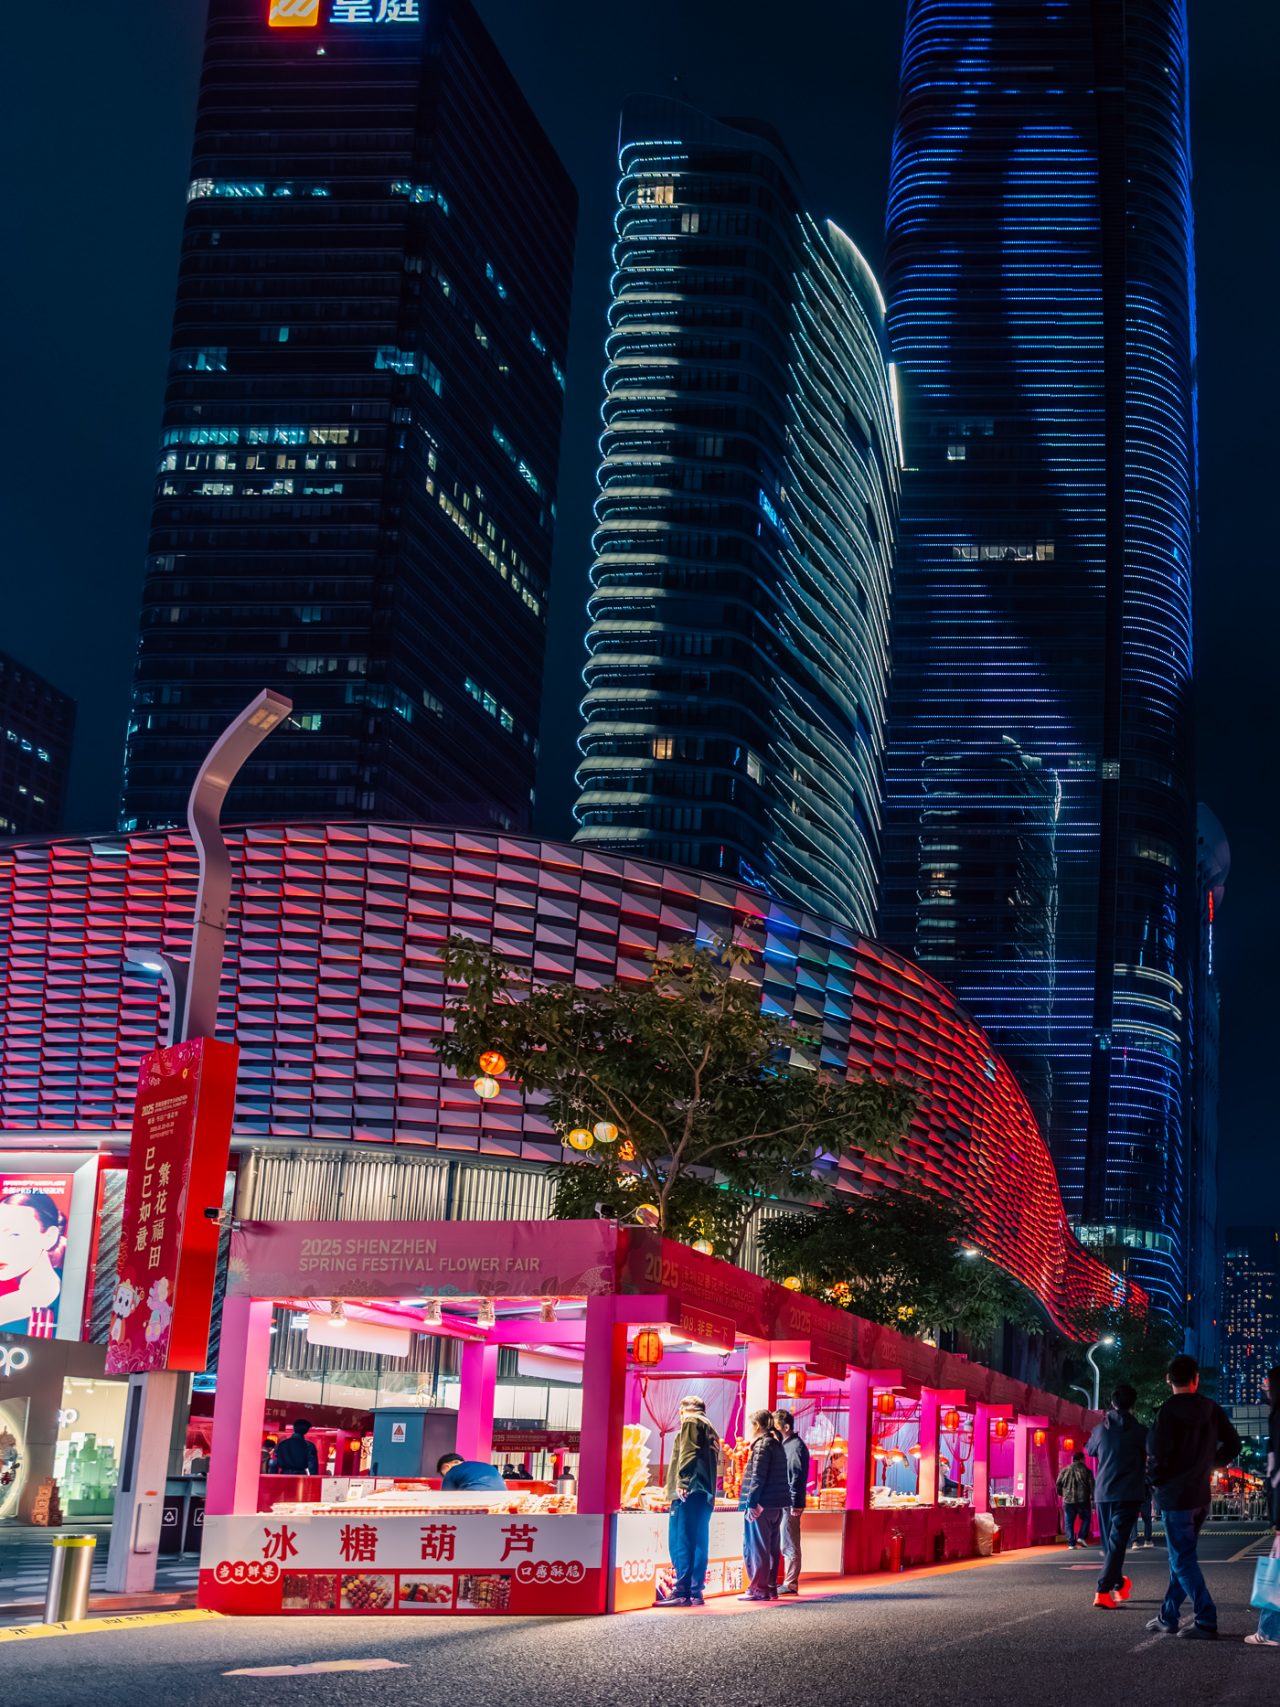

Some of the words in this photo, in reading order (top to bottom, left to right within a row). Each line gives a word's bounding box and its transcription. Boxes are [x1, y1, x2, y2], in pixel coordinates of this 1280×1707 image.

[148, 1162, 171, 1269] 繁花福田
[301, 1239, 341, 1256] 2025
[346, 1239, 437, 1254] SHENZHEN
[299, 1257, 357, 1272] SPRING
[362, 1258, 433, 1271] FESTIVAL
[439, 1258, 500, 1271] FLOWER
[505, 1258, 540, 1271] FAIR
[645, 1253, 678, 1289] 2025
[790, 1306, 811, 1334] 2025
[262, 1523, 538, 1562] 冰糖葫芦
[219, 1565, 275, 1578] 当日鲜果
[521, 1565, 580, 1578] 口感酥脆
